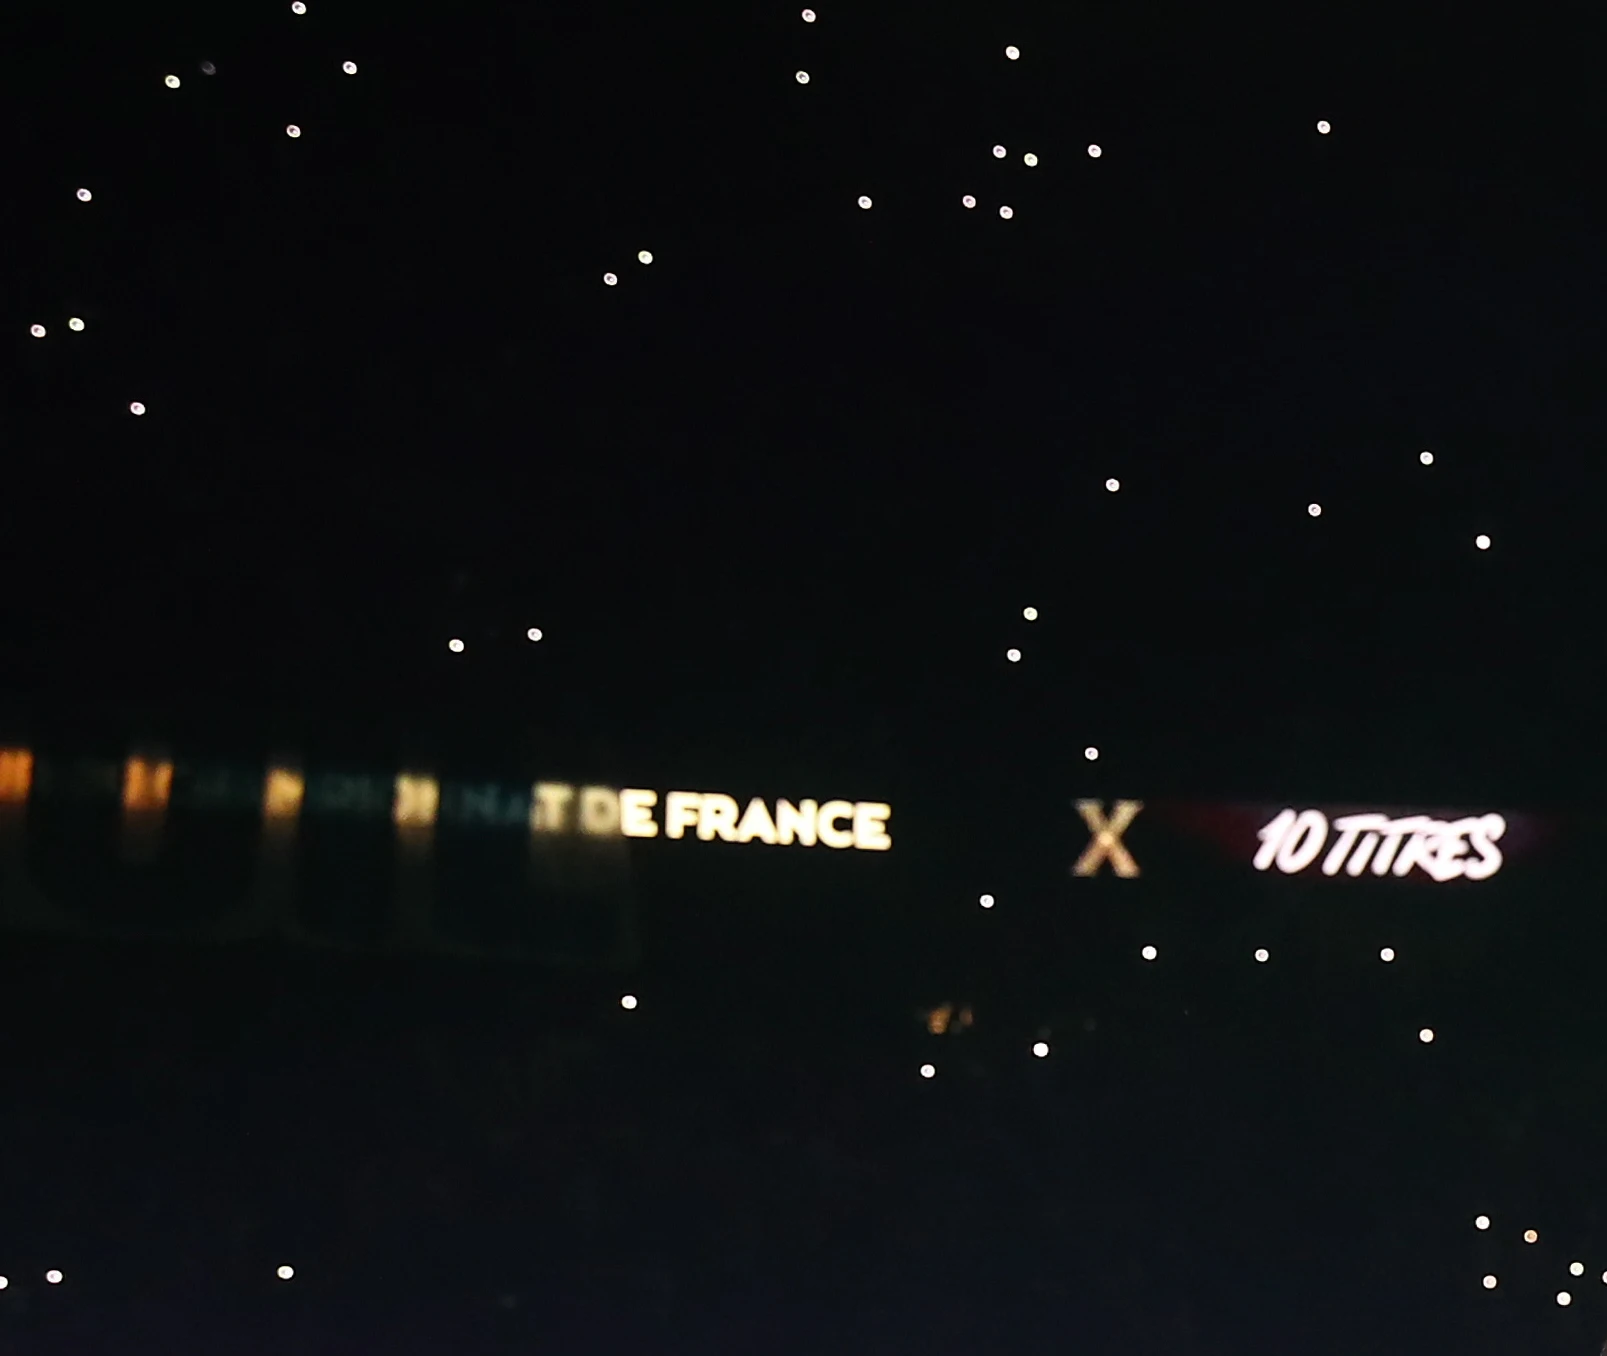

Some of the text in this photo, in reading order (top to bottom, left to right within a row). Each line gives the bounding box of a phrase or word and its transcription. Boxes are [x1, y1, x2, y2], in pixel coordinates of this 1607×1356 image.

[664, 790, 893, 852] FRANCE
[1073, 799, 1143, 879] X
[1252, 808, 1507, 883] 10 TITRES
